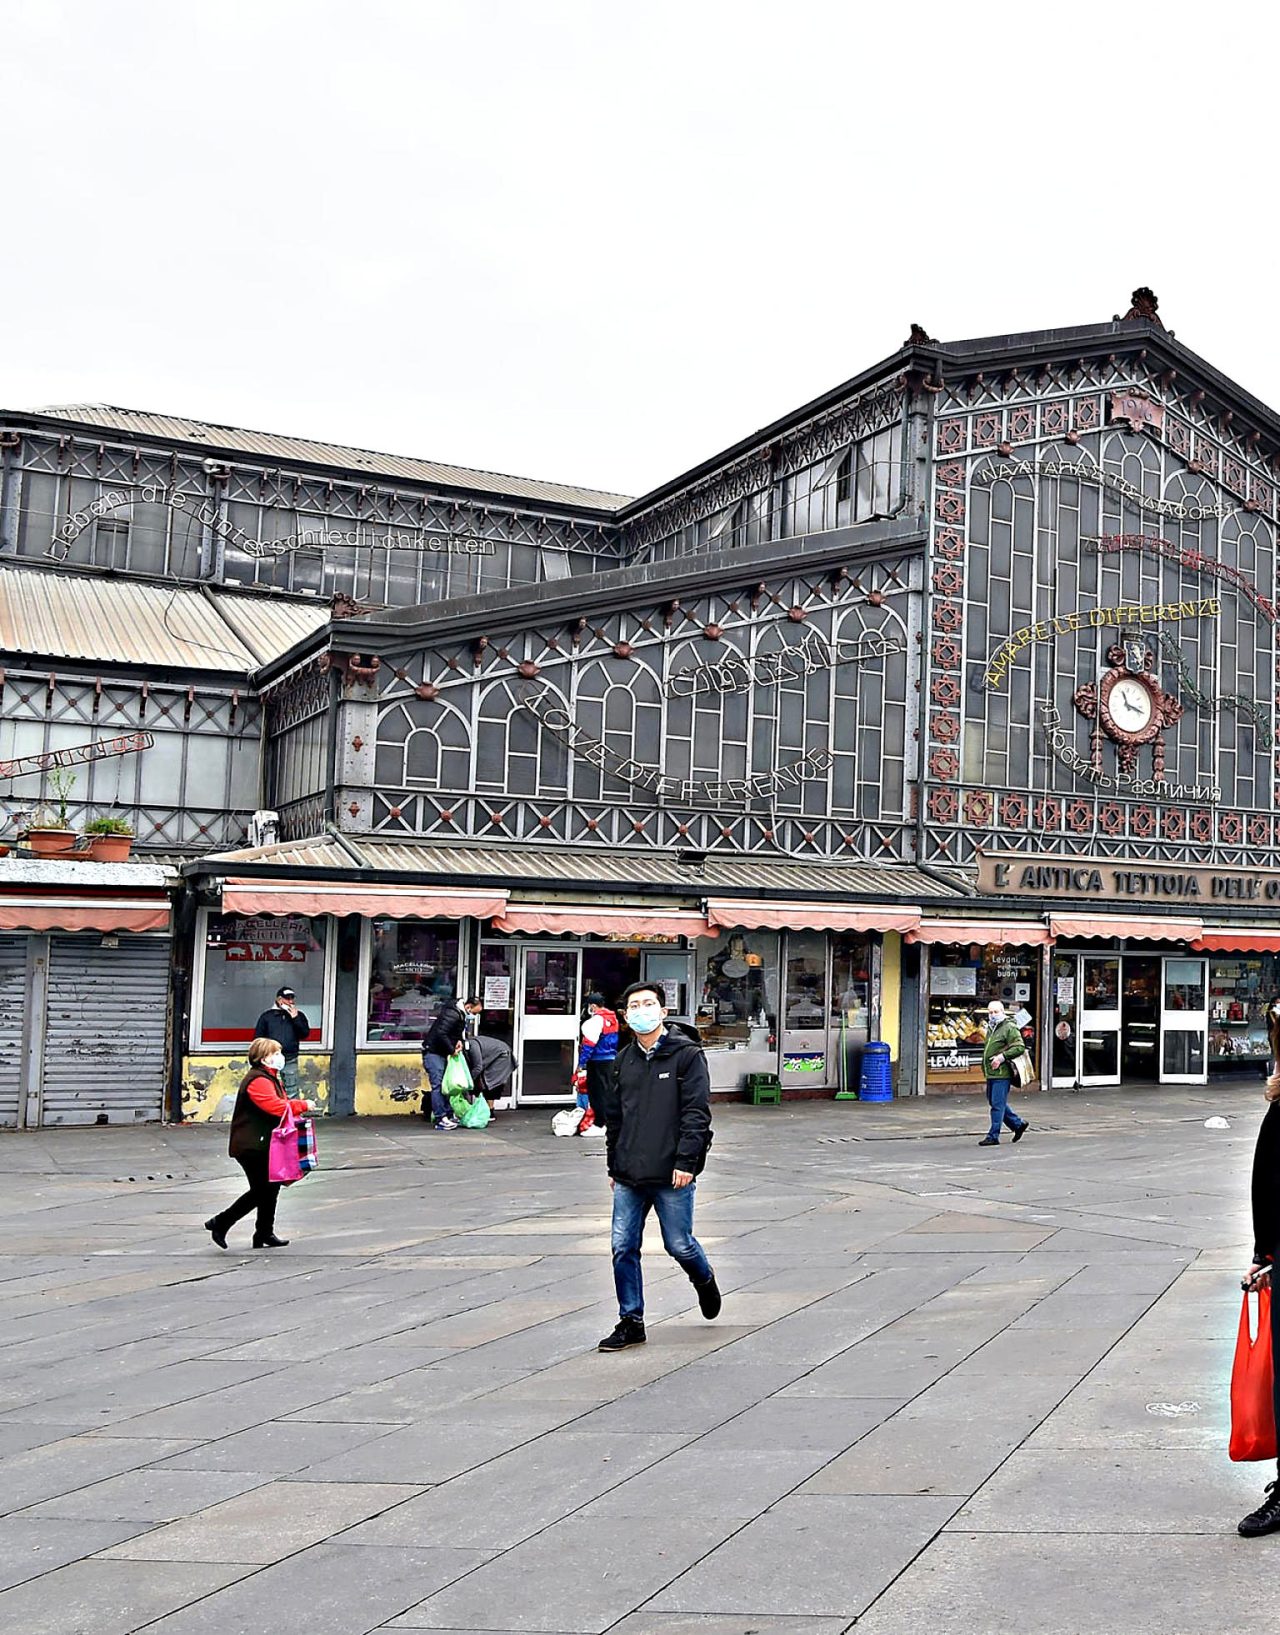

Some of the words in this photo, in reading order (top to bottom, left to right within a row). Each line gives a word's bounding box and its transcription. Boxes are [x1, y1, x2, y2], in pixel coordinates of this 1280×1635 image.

[141, 484, 186, 508] die
[984, 621, 1049, 687] AMARE
[1054, 612, 1081, 634] LE
[1089, 598, 1223, 626] DIFFERENZE
[524, 686, 617, 764] LOVE
[615, 748, 831, 801] DIFFERENCE
[1020, 866, 1104, 891] ANTICA
[1112, 870, 1201, 897] TETTOIA
[931, 1055, 969, 1068] LEVONI
